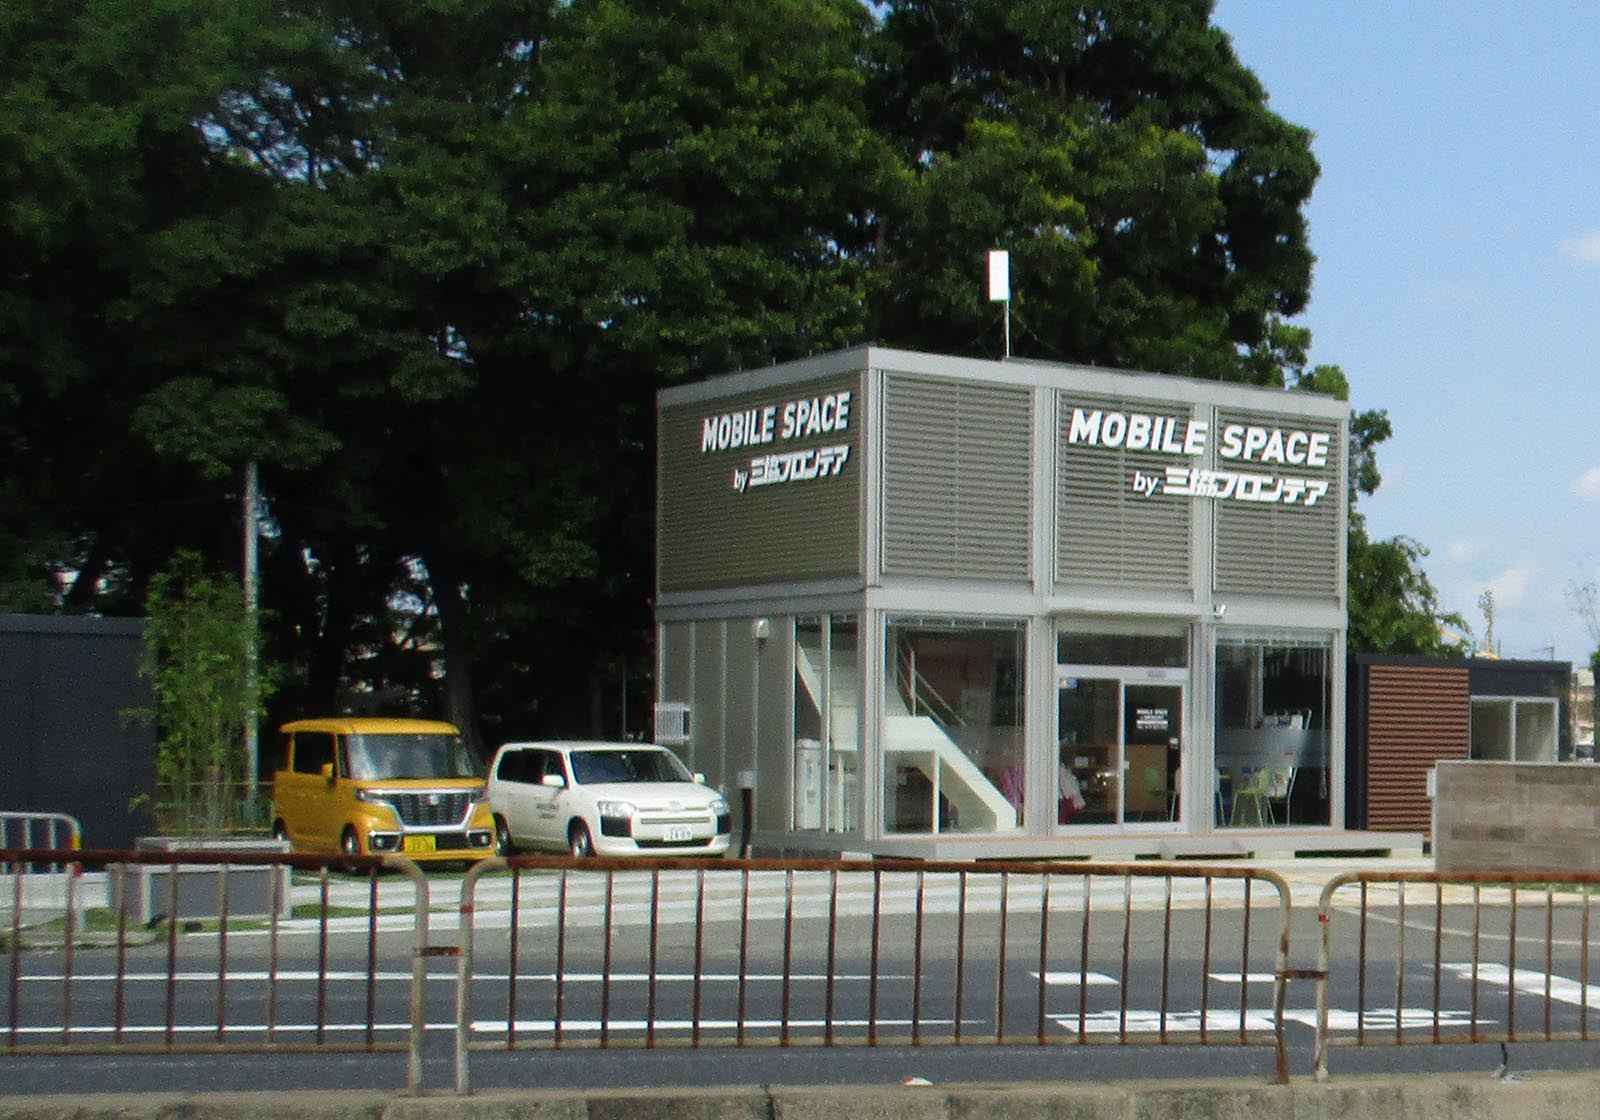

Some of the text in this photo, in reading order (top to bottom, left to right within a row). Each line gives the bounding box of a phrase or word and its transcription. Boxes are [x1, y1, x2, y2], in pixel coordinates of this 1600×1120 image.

[703, 391, 851, 453] MOBILE SPACE
[1069, 408, 1331, 467] MOBILE SPACE
[734, 469, 749, 493] by
[1133, 467, 1329, 506] by 三協フロンテア
